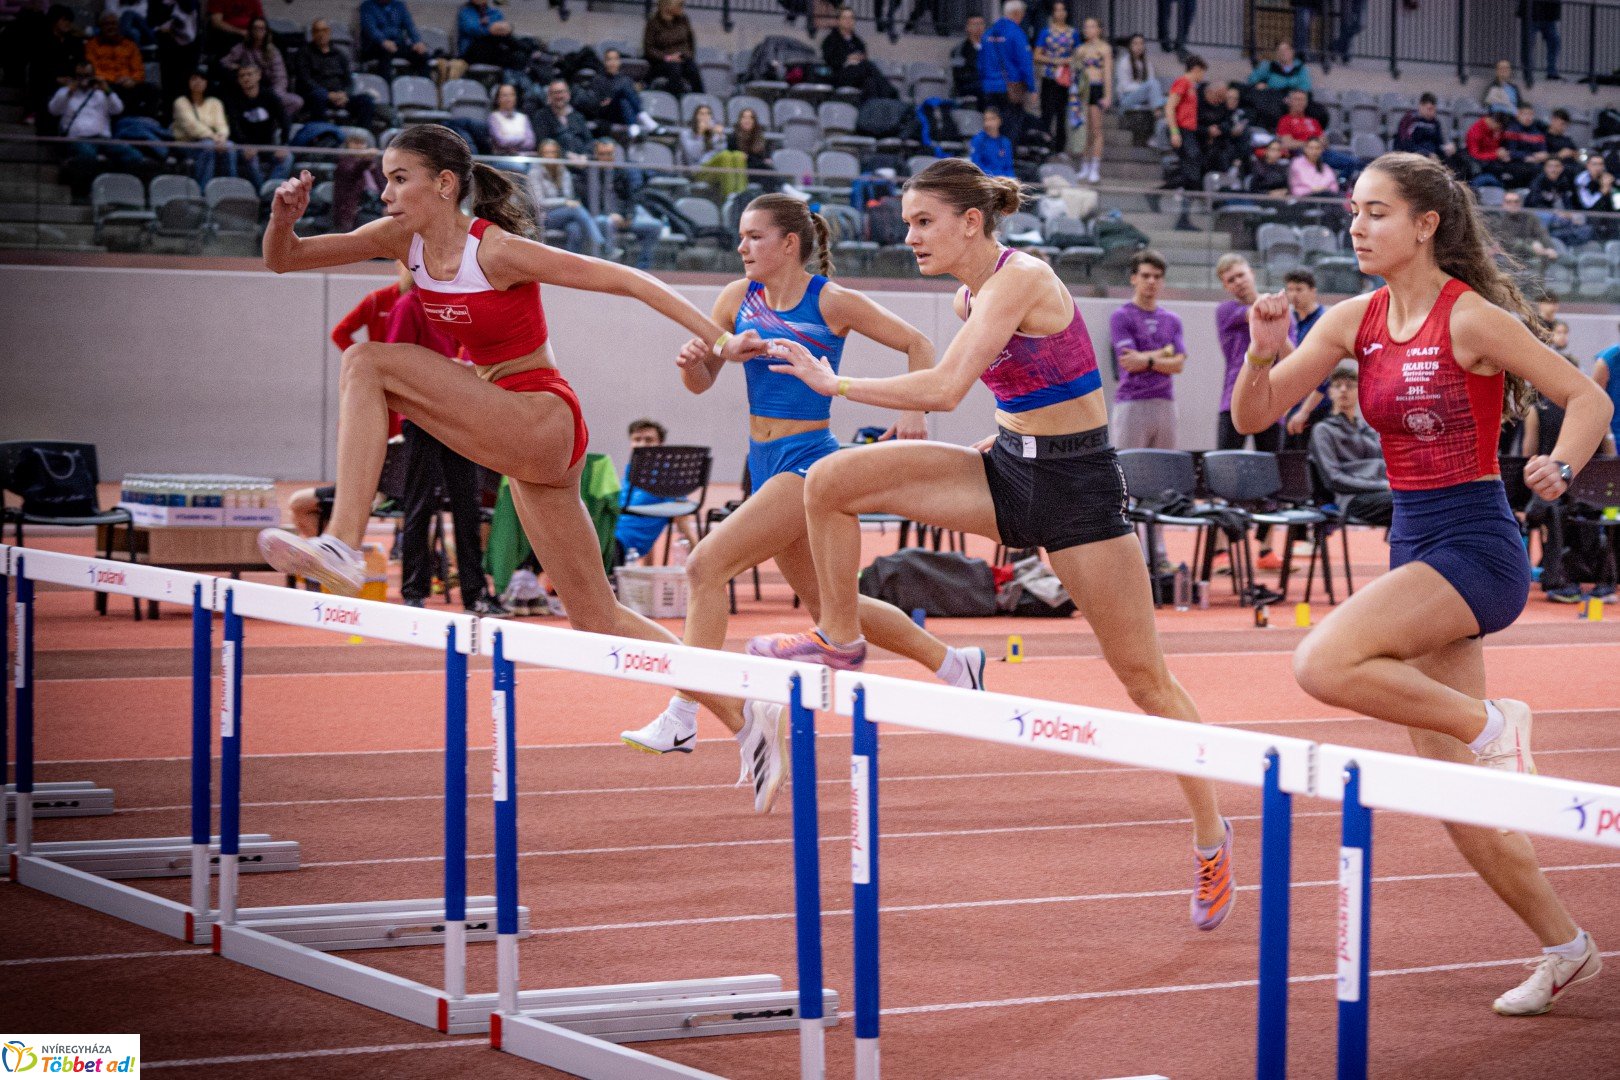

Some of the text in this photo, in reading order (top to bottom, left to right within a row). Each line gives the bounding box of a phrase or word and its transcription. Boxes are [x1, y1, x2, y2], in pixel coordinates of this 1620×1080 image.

[1402, 361, 1440, 371] IKARUS
[1049, 432, 1104, 453] NIKE
[323, 604, 361, 626] polanik
[624, 650, 672, 675] polanik
[1031, 715, 1098, 747] polanik
